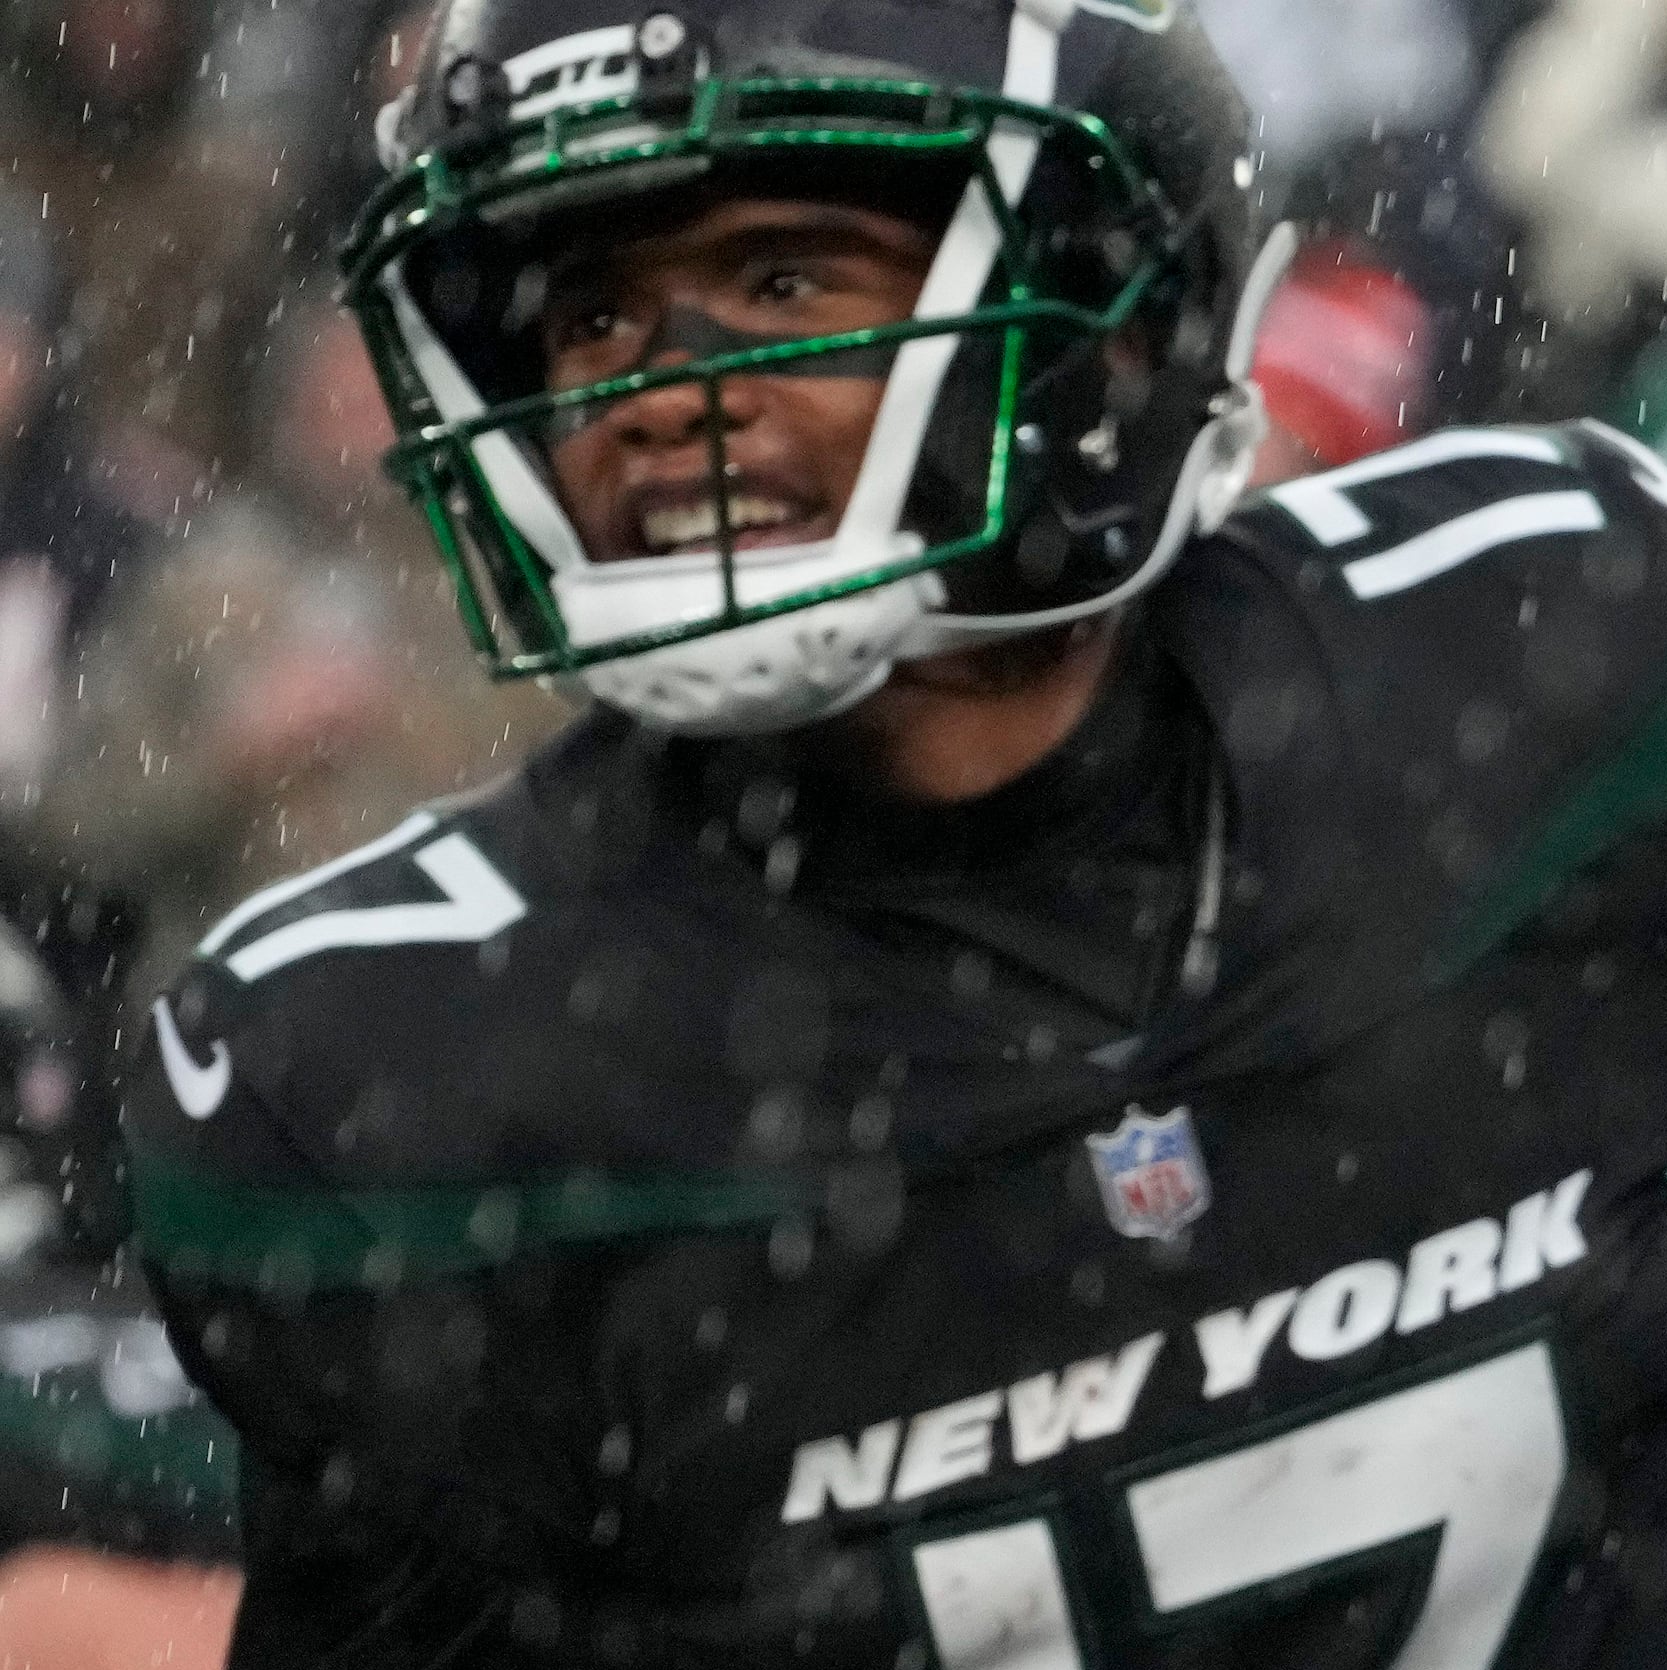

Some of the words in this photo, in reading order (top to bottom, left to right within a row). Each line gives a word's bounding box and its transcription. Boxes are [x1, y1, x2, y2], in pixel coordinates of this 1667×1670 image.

[1268, 429, 1605, 601] 17
[196, 810, 528, 985] 17
[781, 1331, 1165, 1524] NEW
[1194, 1168, 1594, 1401] YORK
